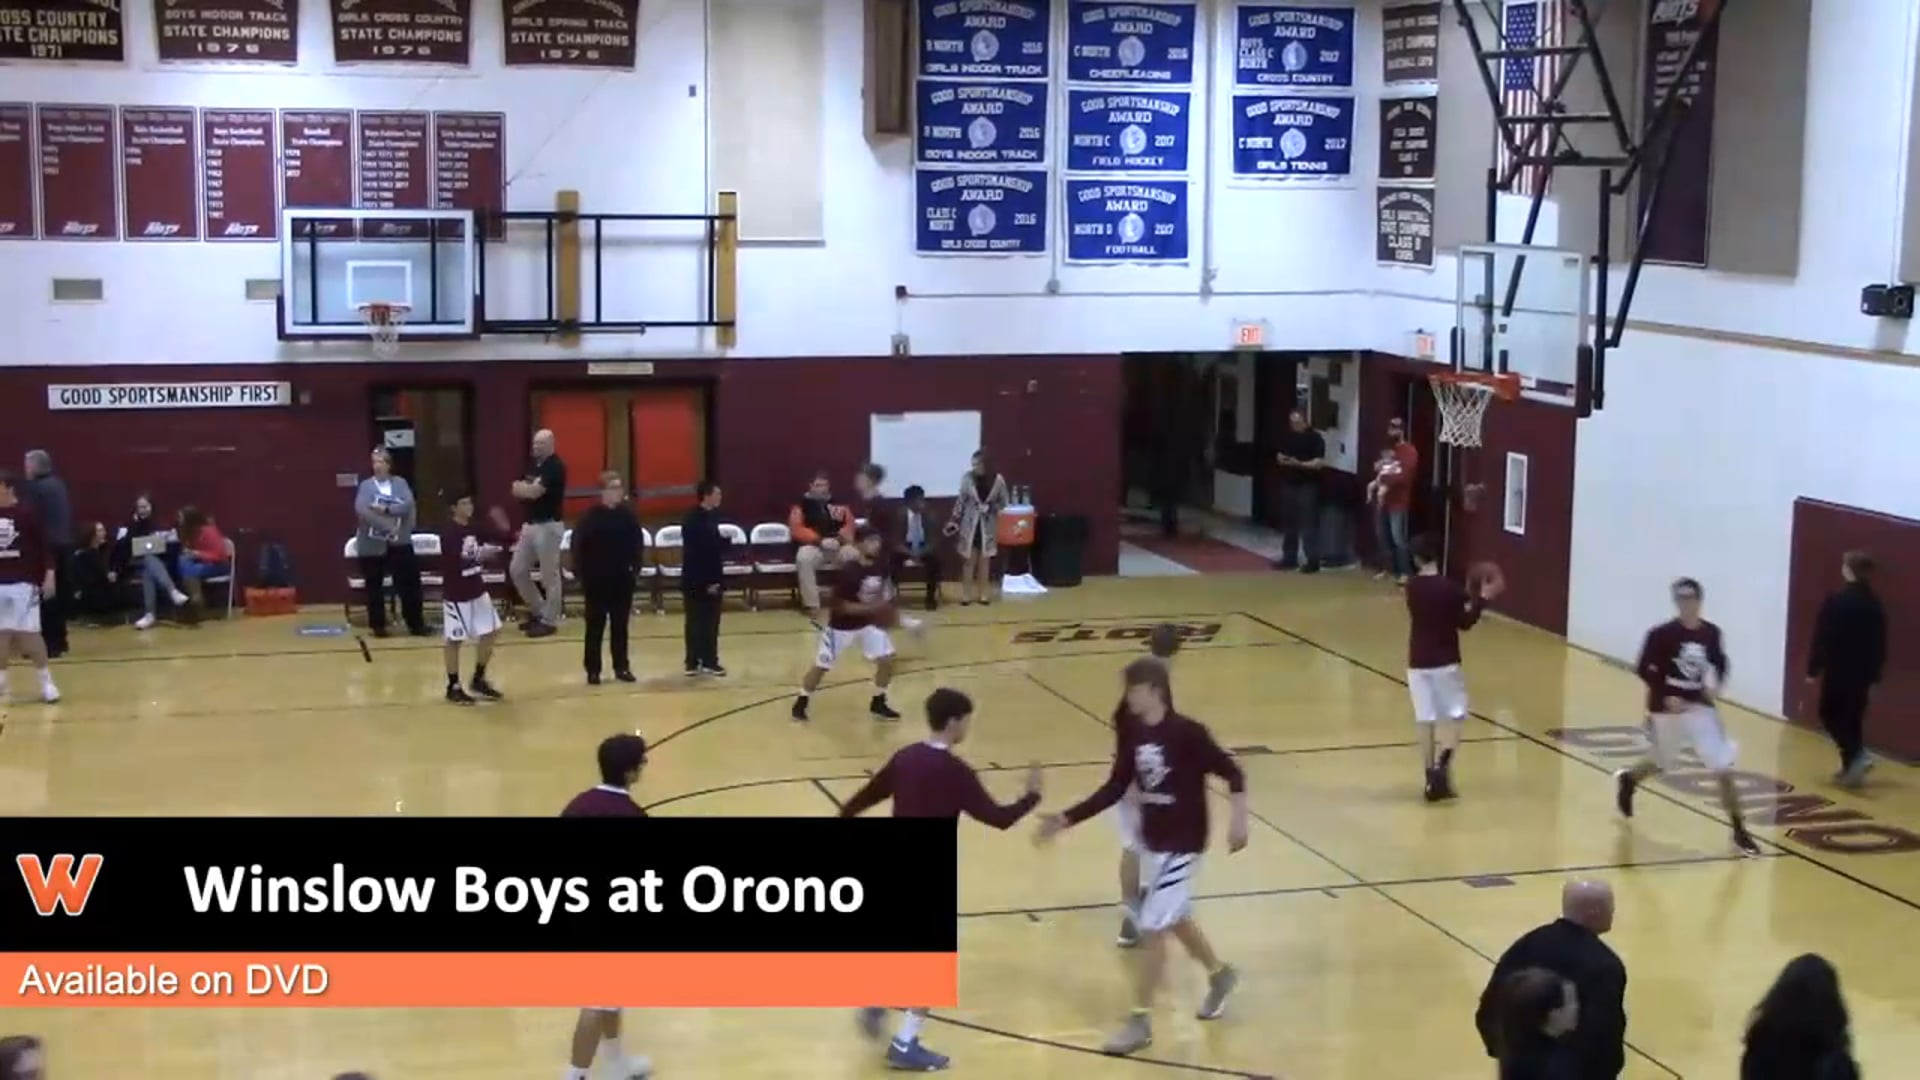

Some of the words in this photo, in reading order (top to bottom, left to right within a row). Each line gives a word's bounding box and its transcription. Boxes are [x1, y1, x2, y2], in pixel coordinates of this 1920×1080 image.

[36, 10, 107, 28] COUNTRY
[165, 10, 196, 20] BOYS
[201, 10, 243, 20] INDOOR
[250, 11, 287, 22] TRACK
[338, 13, 369, 23] GIRLS
[374, 13, 409, 23] CROSS
[415, 14, 463, 25] COUNTRY
[964, 16, 1006, 29] AWARD
[1273, 11, 1344, 31] SPORTSMANSHIP
[511, 17, 543, 28] GIRLS
[594, 20, 628, 30] TRACK
[1112, 21, 1153, 34] AWARD
[28, 27, 119, 46] CHAMPIONS
[163, 25, 207, 38] STATE
[212, 26, 290, 40] CHAMPIONS
[341, 28, 383, 41] STATE
[388, 29, 463, 43] CHAMPIONS
[1274, 26, 1316, 38] AWARD
[511, 32, 551, 45] STATE
[557, 33, 630, 47] CHAMPIONS
[31, 44, 62, 57] 1971
[925, 63, 958, 73] GIRLS
[961, 63, 1001, 74] INDOOR
[1004, 65, 1042, 74] TRACK
[1089, 69, 1171, 79] CHEERLEADING
[1257, 73, 1289, 82] CROSS
[1292, 74, 1334, 83] COUNTRY
[931, 88, 955, 104] GOOD
[958, 86, 1033, 105] SPORTSMANSHIP
[961, 102, 1004, 114] AWARD
[1081, 98, 1105, 113] GOOD
[1107, 95, 1180, 116] SPORTSMANSHIP
[1246, 101, 1268, 118] GOOD
[1269, 99, 1341, 119] SPORTSMANSHIP
[1108, 111, 1152, 123] AWARD
[1273, 113, 1314, 126] AWARD
[932, 126, 962, 138] NORTH
[1074, 134, 1103, 147] NORTH
[1104, 135, 1111, 146] C
[1154, 135, 1175, 147] 2017
[925, 149, 954, 159] BOYS
[957, 149, 998, 160] INDOOR
[1001, 150, 1038, 160] TRACK
[1092, 156, 1121, 166] FIELD
[1124, 156, 1164, 167] HOCKEY
[1257, 161, 1288, 171] GIRLS
[1290, 161, 1328, 171] TENNIS
[931, 177, 955, 193] GOOD
[956, 174, 1033, 193] SPORTSMANSHIP
[961, 189, 1004, 201] AWARD
[1078, 187, 1102, 203] GOOD
[1103, 185, 1177, 205] SPORTSMANSHIP
[1105, 200, 1149, 212] AWARD
[926, 207, 950, 218] CLASS
[951, 207, 957, 219] C
[1074, 223, 1104, 235] NORTH
[941, 240, 962, 249] GIRLS
[963, 240, 987, 249] CROSS
[989, 240, 1021, 249] COUNTRY
[1388, 235, 1413, 249] CLASS
[1105, 245, 1158, 255] FOOTBALL
[1241, 327, 1259, 343] EXIT
[60, 388, 100, 405] GOOD
[109, 386, 232, 404] SPORTSMANSHIP
[240, 385, 279, 402] FIRST
